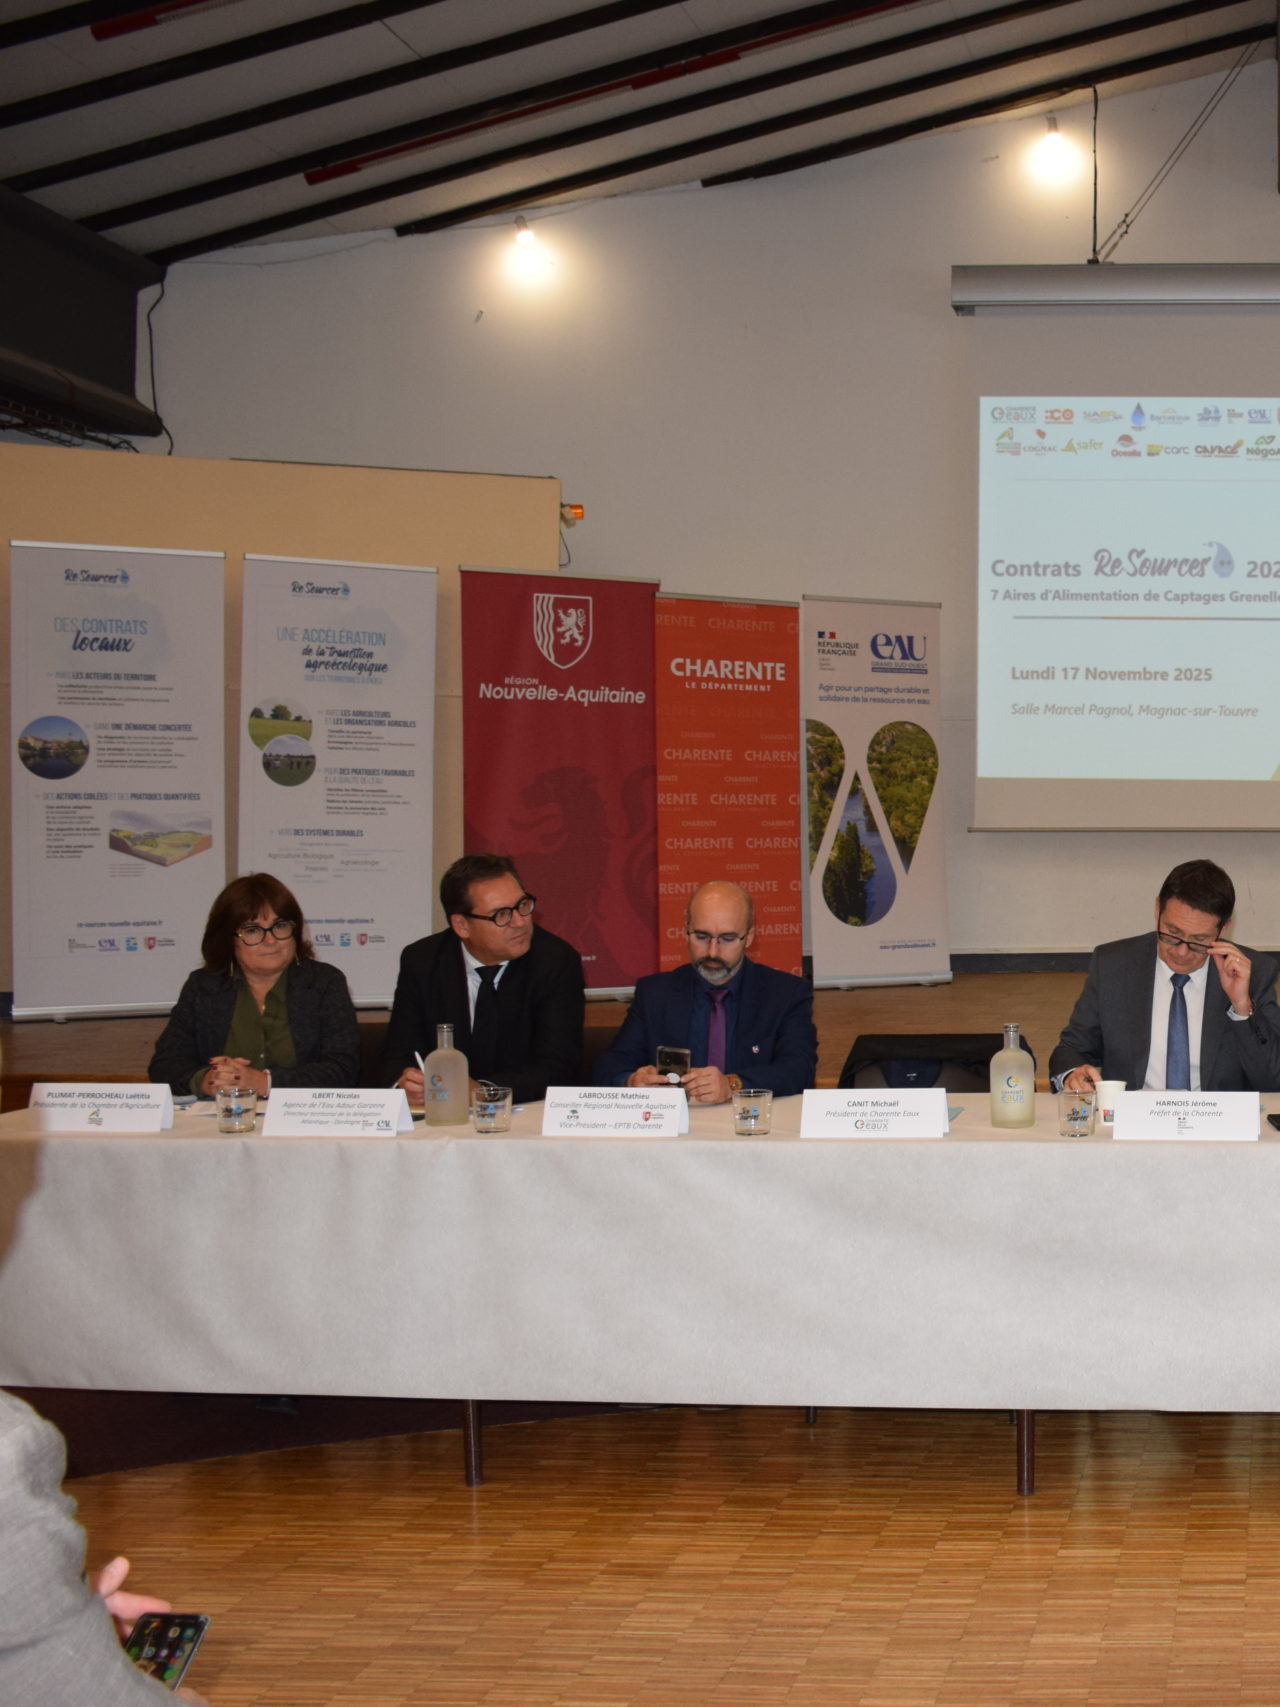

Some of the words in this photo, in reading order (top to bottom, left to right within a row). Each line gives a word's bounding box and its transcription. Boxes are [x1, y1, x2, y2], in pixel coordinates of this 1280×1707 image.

[1023, 445, 1058, 453] COGNAC
[1078, 438, 1104, 450] safer
[991, 559, 1081, 577] Contrats
[80, 569, 118, 584] Sources
[305, 581, 340, 596] Sources
[991, 589, 999, 601] 7
[1003, 589, 1037, 601] Aires
[1040, 589, 1139, 602] d'Alimentation
[1143, 589, 1160, 602] de
[1164, 590, 1225, 605] Captages
[54, 617, 78, 632] DES
[82, 617, 148, 636] CONTRATS
[708, 617, 776, 632] CHARENTE
[72, 630, 136, 653] locaux
[276, 627, 298, 642] UNE
[302, 626, 386, 647] ACCÉLÉRATION
[302, 645, 312, 656] de
[316, 645, 325, 656] la
[817, 640, 859, 650] RÉPUBLIQUE
[817, 649, 857, 657] FRANÇAISE
[305, 659, 388, 677] agroécologique
[670, 657, 786, 681] CHARENTE
[1011, 666, 1055, 681] Lundi
[1061, 667, 1080, 681] 17
[1084, 667, 1169, 681] Novembre
[1174, 667, 1213, 682] 2025
[504, 675, 539, 686] RÉGION
[685, 681, 696, 689] LE
[701, 681, 771, 692] DÉPARTEMENT
[818, 684, 834, 693] Agir
[835, 685, 852, 693] pour
[864, 685, 892, 695] partage
[894, 686, 921, 694] durable
[922, 687, 930, 695] et
[479, 683, 647, 707] Nouvelle-Aquitaine
[818, 694, 850, 703] solidaire
[851, 695, 861, 703] de
[862, 695, 869, 703] la
[869, 697, 906, 705] ressource
[1011, 704, 1040, 716] Salle
[1043, 704, 1084, 716] Marcel
[1088, 705, 1133, 719] Pagnol,
[1138, 705, 1258, 719] Magnac-sur-Touvre
[664, 748, 733, 761] CHARENTE
[710, 793, 777, 806] CHARENTE
[665, 838, 734, 849] CHARENTE
[46, 1091, 124, 1100] PLUMAT-PERROCHEAU
[126, 1090, 151, 1100] Laëtitia
[579, 1092, 619, 1100] LABROUSSE
[621, 1092, 650, 1100] Mathieu
[88, 1101, 117, 1109] Chambre
[119, 1101, 161, 1110] d'Agriculture
[282, 1102, 308, 1110] Agence
[335, 1102, 356, 1110] Adour
[356, 1103, 386, 1111] Garonne
[584, 1102, 613, 1111] Régional
[614, 1102, 644, 1110] Nouvelle
[645, 1103, 677, 1111] Aquitaine
[871, 1100, 899, 1108] Michaël
[1191, 1099, 1217, 1107] Jérôme
[825, 1110, 858, 1118] Président
[1149, 1109, 1171, 1117] Préfet
[1191, 1110, 1223, 1118] Charente
[560, 1121, 607, 1129] Vice-Président
